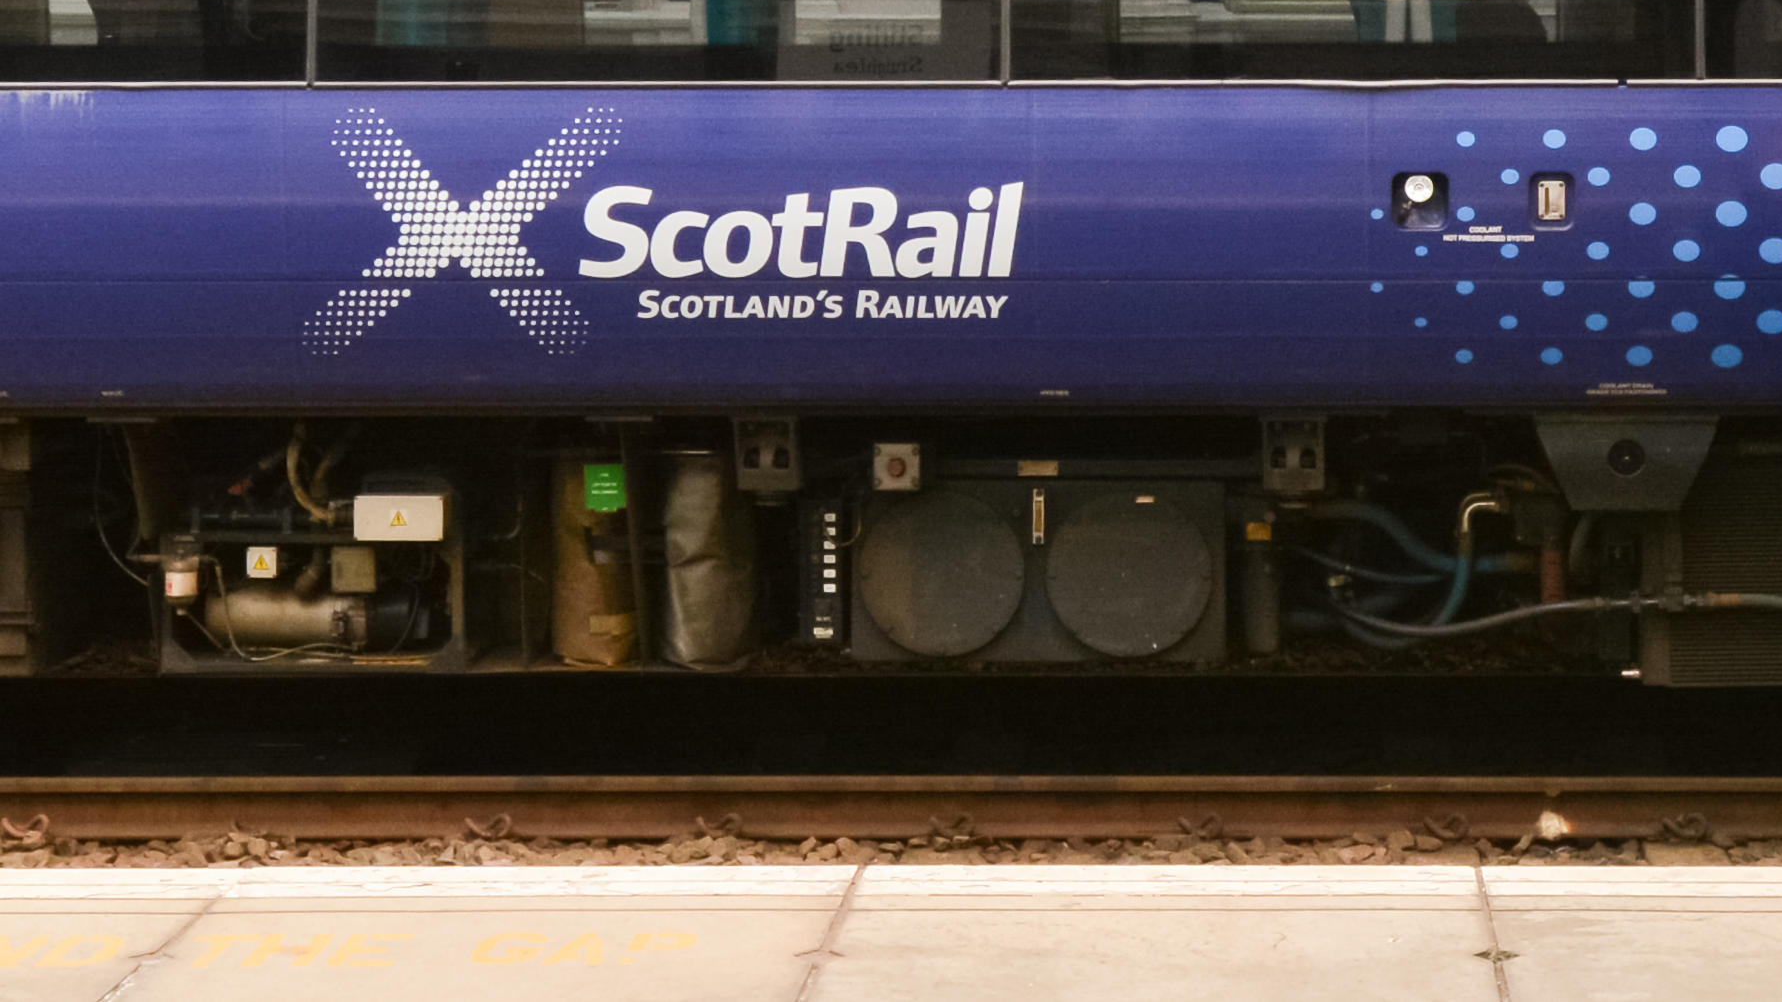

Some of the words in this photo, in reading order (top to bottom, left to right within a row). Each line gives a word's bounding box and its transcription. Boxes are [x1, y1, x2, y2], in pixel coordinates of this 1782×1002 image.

[578, 181, 1024, 279] ScotRail
[1468, 225, 1503, 234] COOLANT
[1507, 234, 1535, 242] SYSTEM
[855, 289, 1008, 319] RAILWAY
[189, 933, 415, 968] THE
[470, 931, 698, 966] GAP
